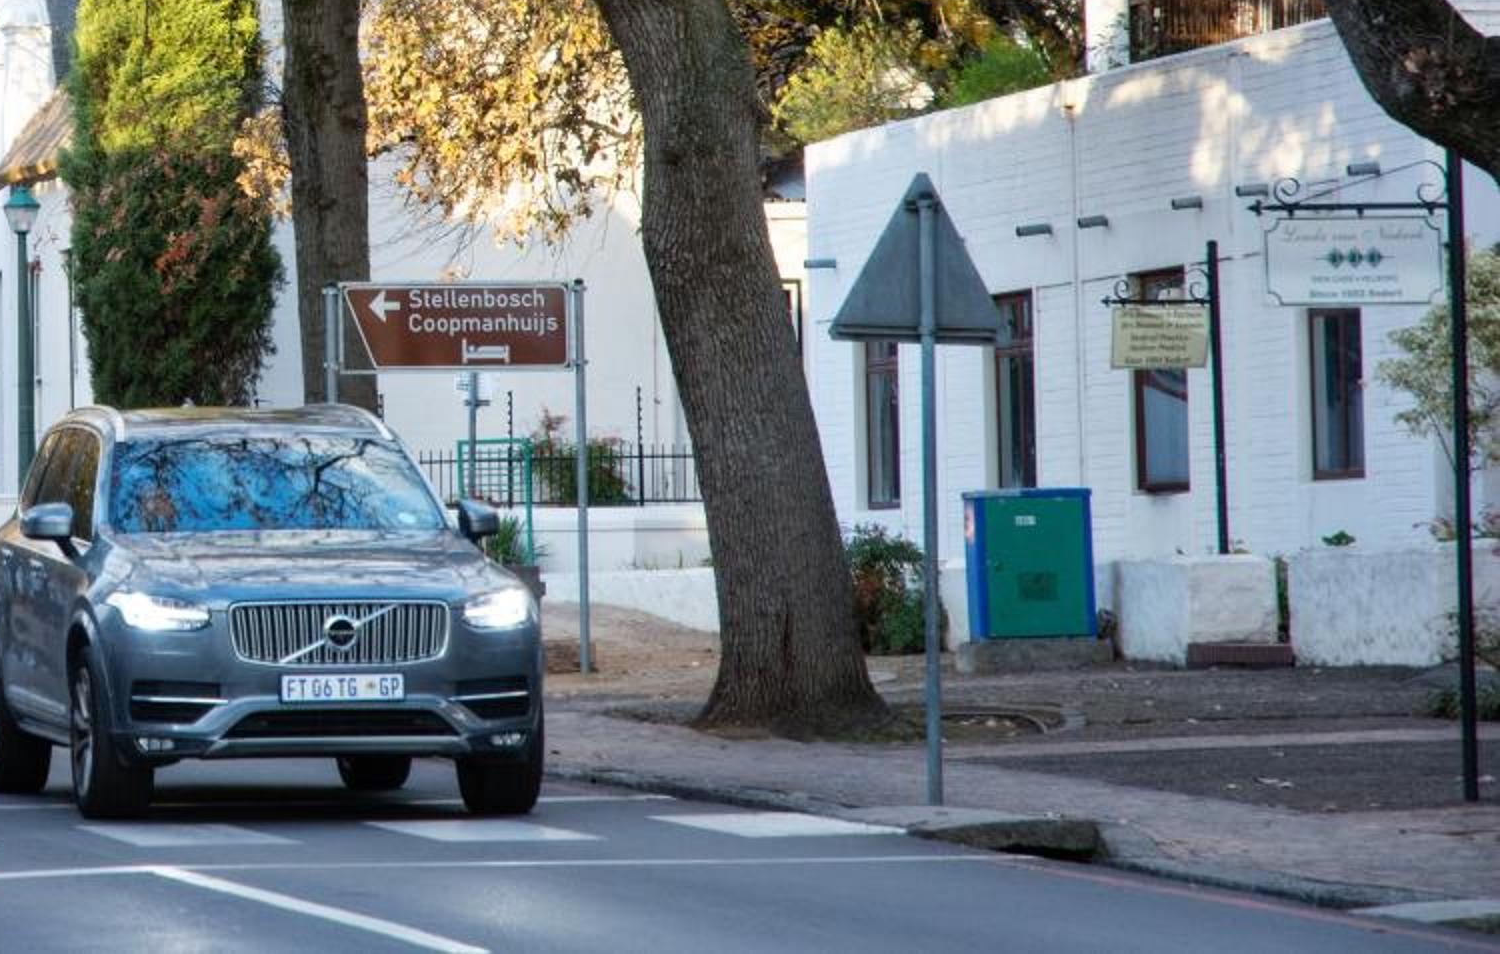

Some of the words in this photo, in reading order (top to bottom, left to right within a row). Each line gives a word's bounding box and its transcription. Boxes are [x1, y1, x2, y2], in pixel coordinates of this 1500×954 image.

[408, 289, 545, 309] Stellenbosch
[408, 311, 559, 337] Coopmanhuijs
[379, 677, 400, 696] GP
